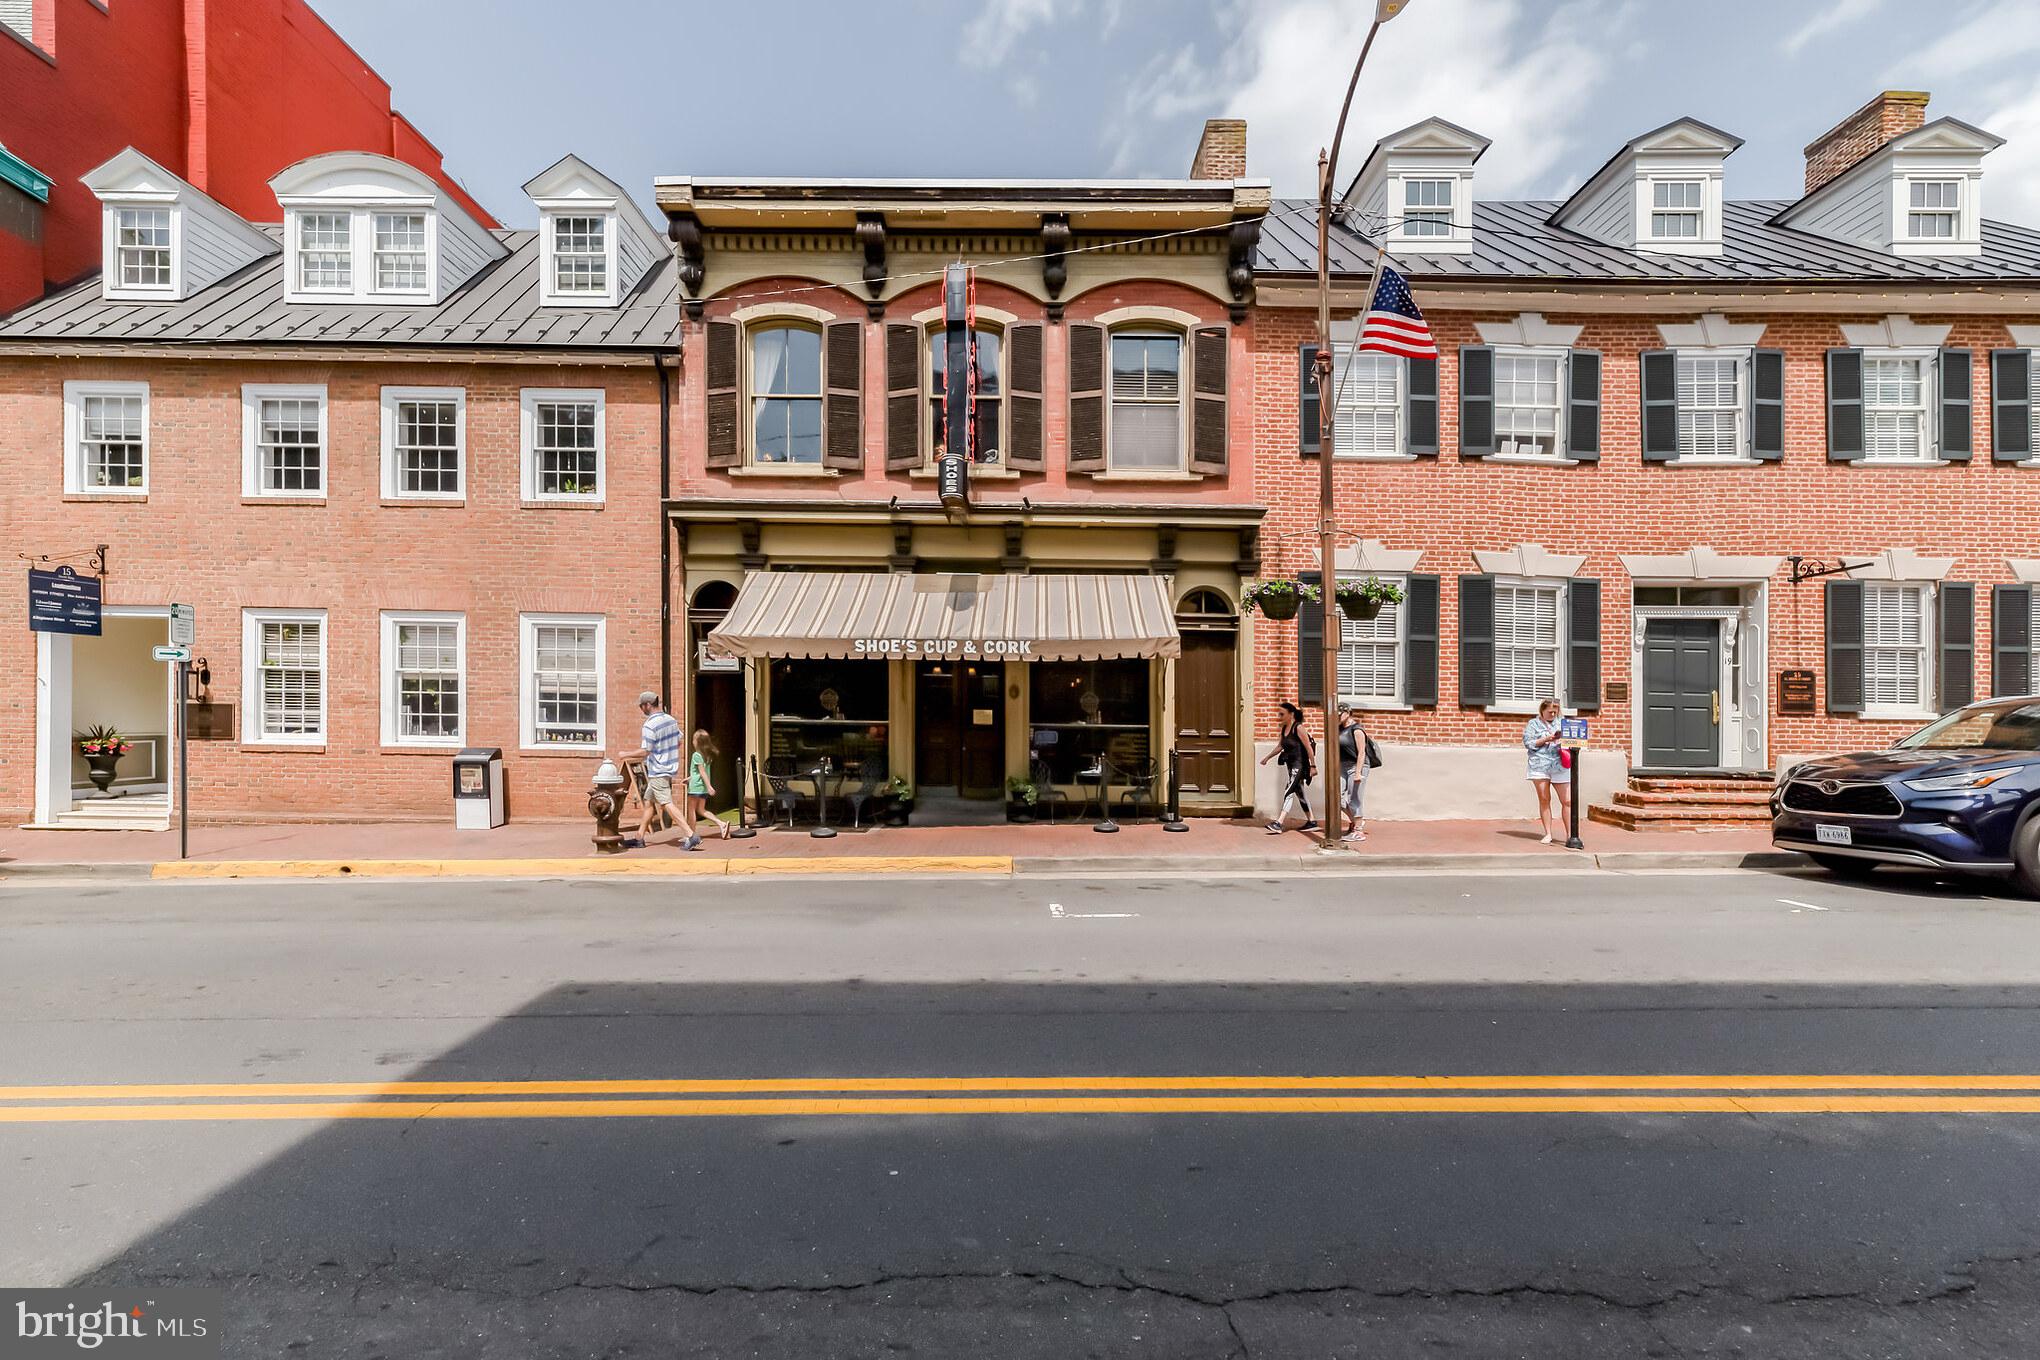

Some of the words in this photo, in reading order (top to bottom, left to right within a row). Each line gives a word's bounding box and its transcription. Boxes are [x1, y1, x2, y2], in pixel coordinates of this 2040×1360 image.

[62, 567, 72, 576] 15
[854, 639, 917, 653] SHOE'S
[923, 639, 958, 654] CUP
[963, 640, 977, 654] &
[983, 640, 1032, 654] CORK
[1724, 656, 1732, 666] 19
